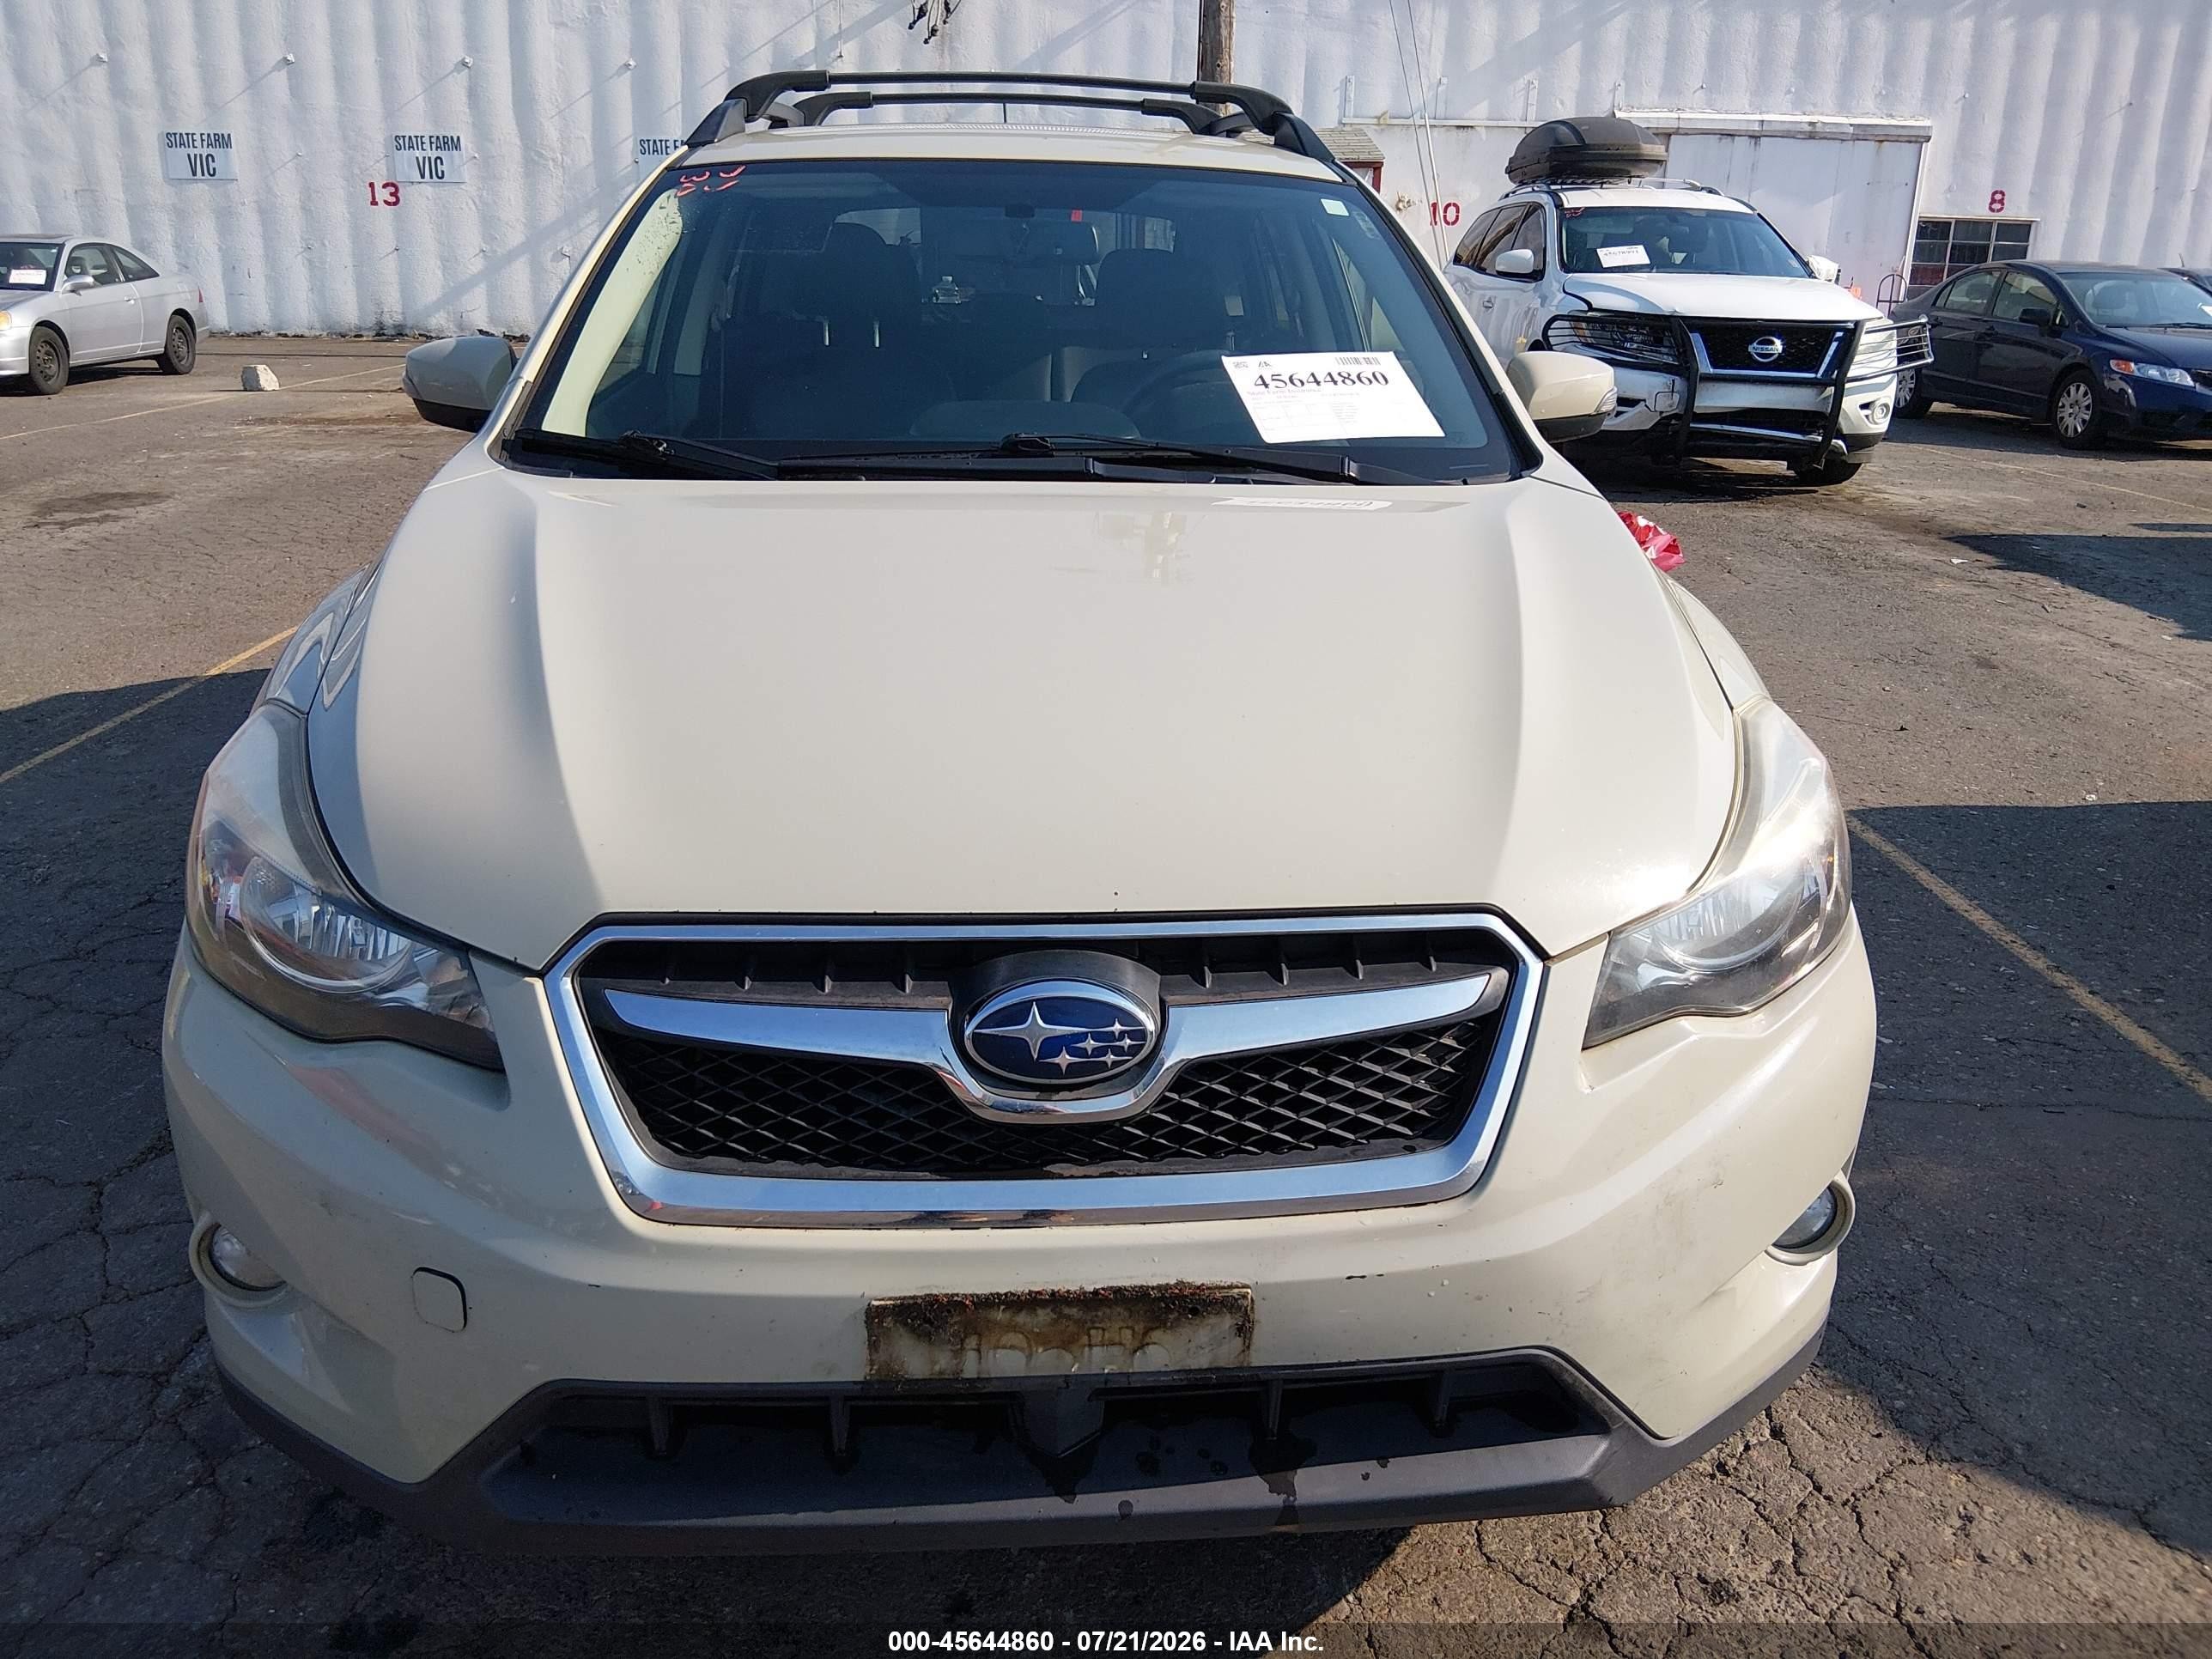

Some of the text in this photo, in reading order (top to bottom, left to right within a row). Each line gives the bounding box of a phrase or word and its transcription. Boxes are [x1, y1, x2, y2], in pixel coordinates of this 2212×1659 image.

[166, 132, 233, 149] STATE FARM
[394, 135, 461, 152] STATE FARM
[639, 138, 670, 155] STATE
[187, 153, 216, 177] VIC
[416, 155, 445, 179] VIC
[368, 181, 400, 206] 13
[1988, 190, 2005, 213] 8
[1430, 202, 1460, 226] 10
[1254, 371, 1389, 389] 45644860
